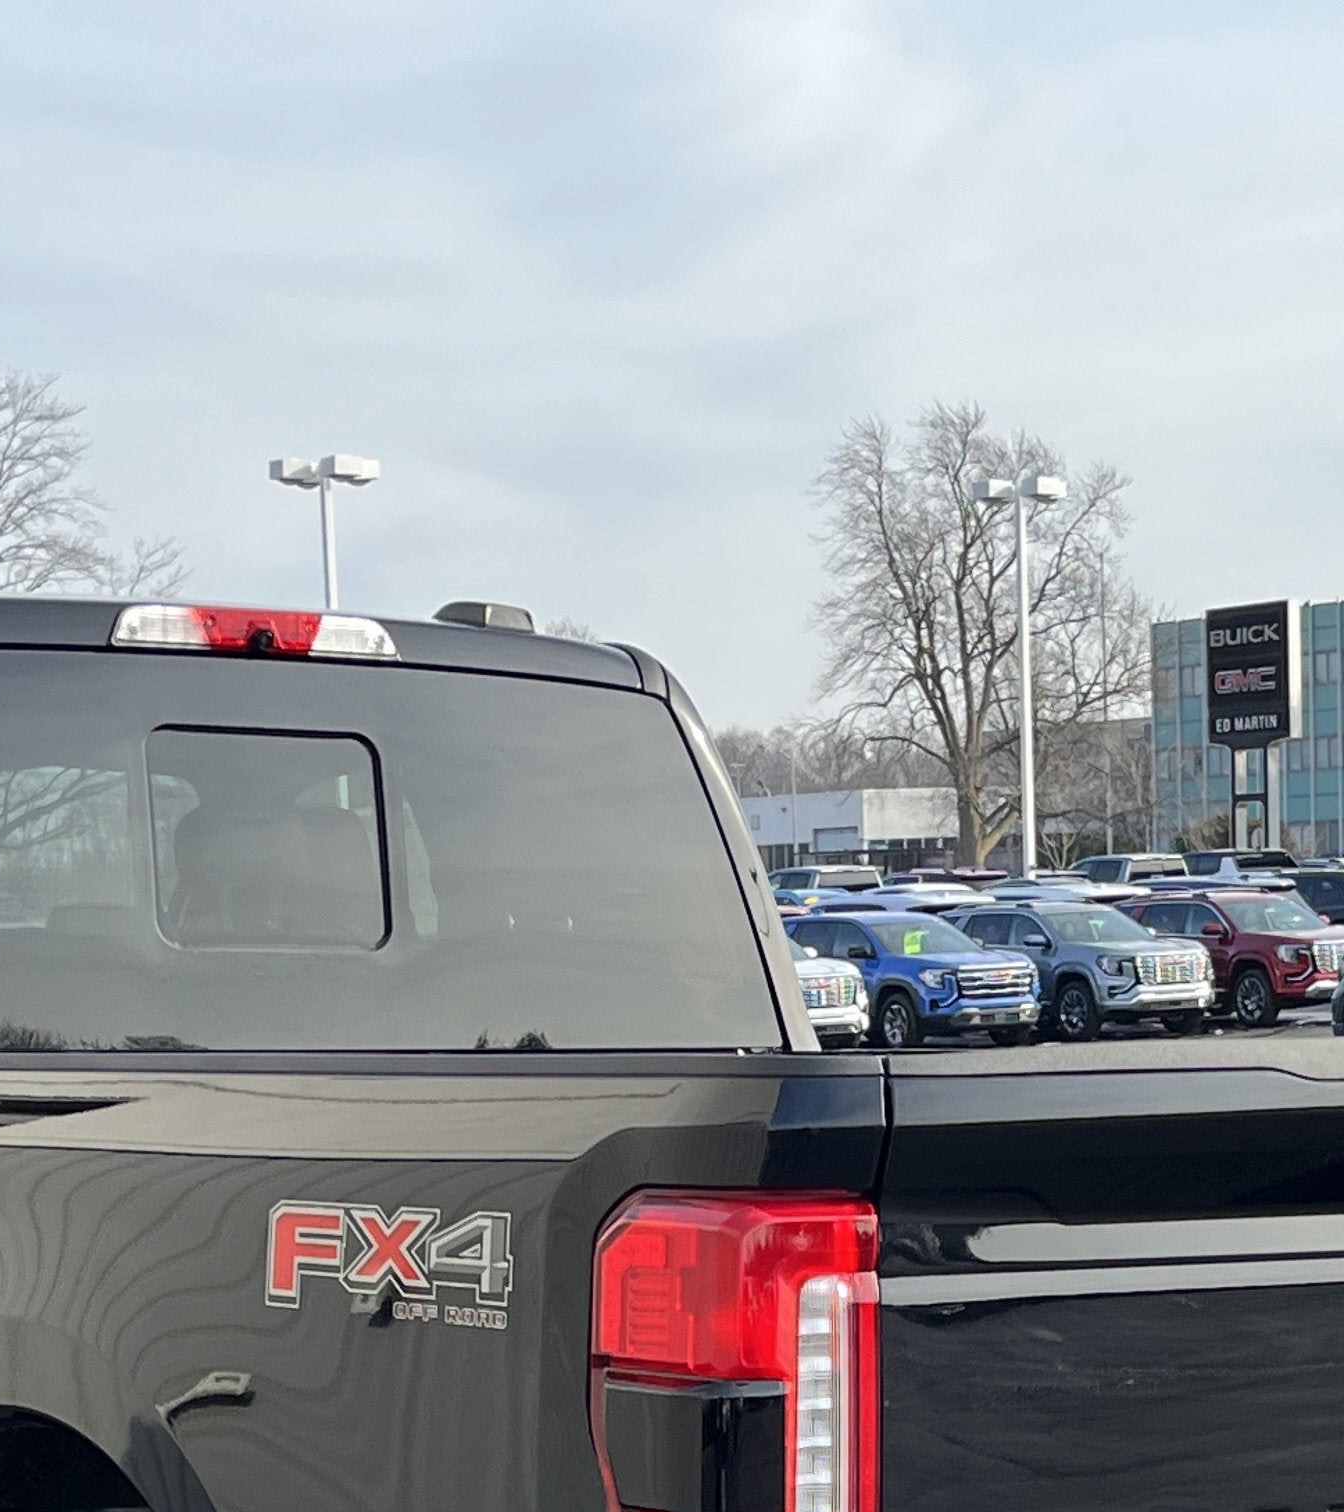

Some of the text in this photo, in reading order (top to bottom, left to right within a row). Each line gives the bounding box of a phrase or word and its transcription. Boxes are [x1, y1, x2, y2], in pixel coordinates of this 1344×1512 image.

[1209, 623, 1280, 648] BUICK
[1214, 666, 1276, 694] GMC
[1215, 714, 1278, 733] ED MARTIN
[265, 1200, 513, 1309] FX4
[392, 1301, 507, 1329] OFF ROAD
